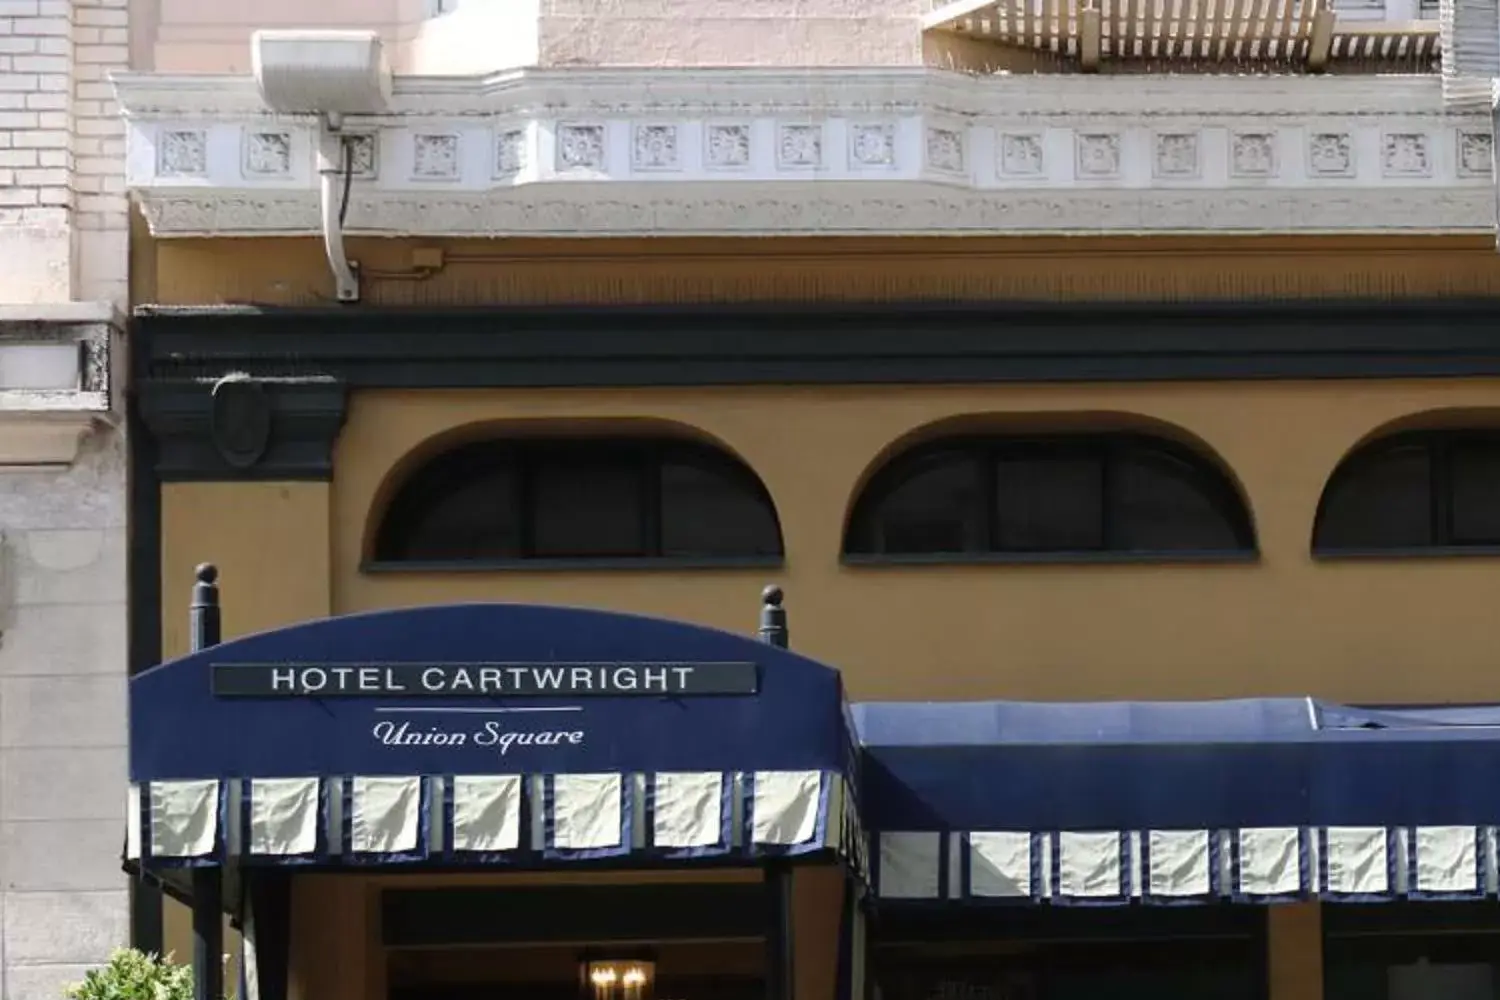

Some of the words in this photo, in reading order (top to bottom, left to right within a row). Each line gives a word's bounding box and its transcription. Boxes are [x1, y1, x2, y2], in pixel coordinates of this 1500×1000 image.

[271, 667, 406, 691] HOTEL
[421, 667, 694, 691] CARTWRIGHT
[373, 720, 467, 745] Union
[473, 720, 585, 756] Square
